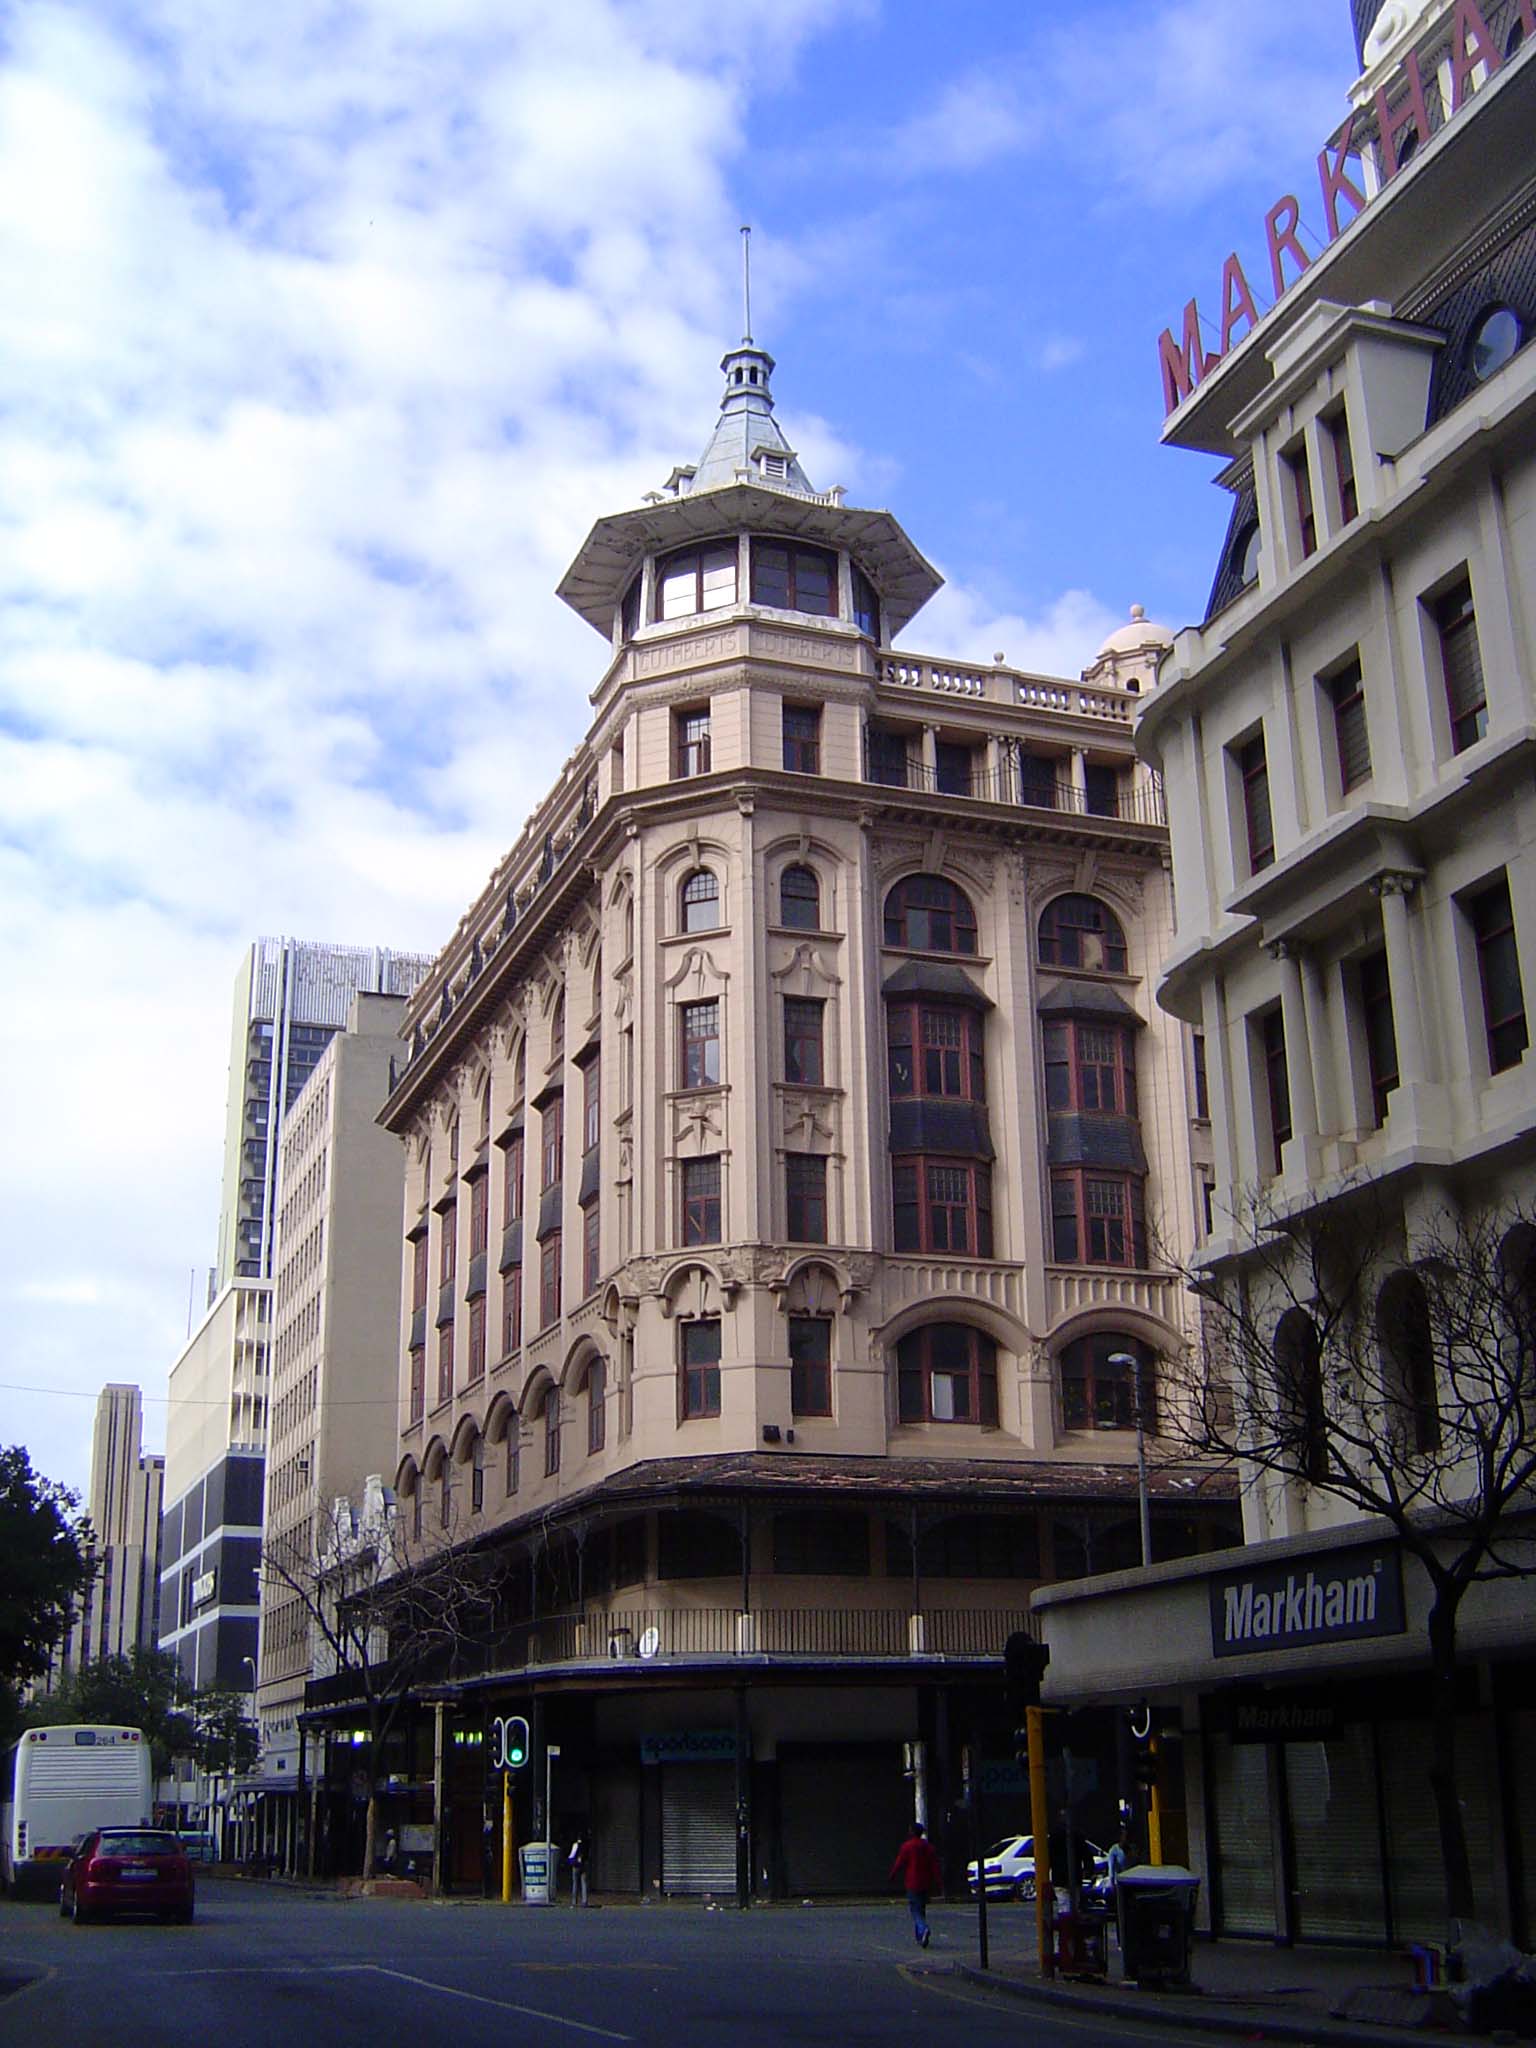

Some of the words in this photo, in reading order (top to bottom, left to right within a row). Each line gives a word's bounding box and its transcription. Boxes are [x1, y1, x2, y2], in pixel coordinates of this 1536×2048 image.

[1157, 0, 1536, 418] MARKHA
[639, 630, 738, 672] CUTHBERTS
[1224, 1571, 1377, 1641] Markham
[1236, 1704, 1334, 1730] Markham
